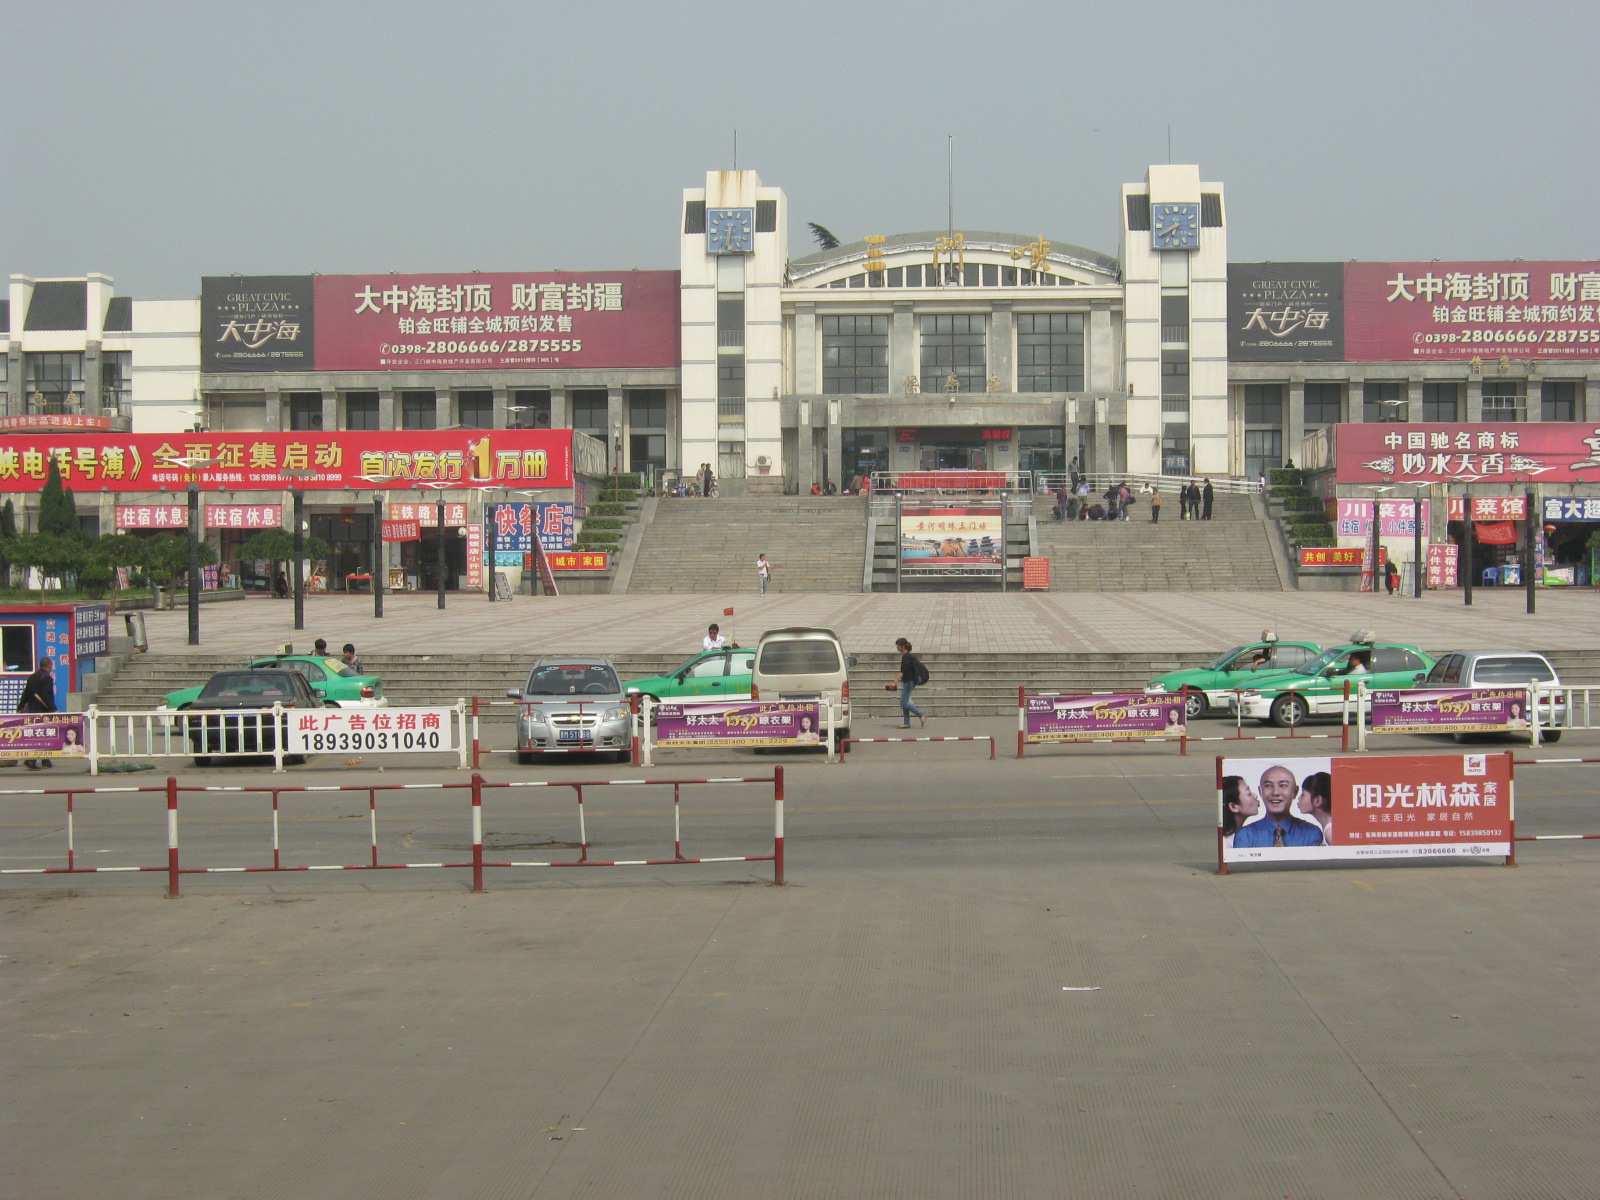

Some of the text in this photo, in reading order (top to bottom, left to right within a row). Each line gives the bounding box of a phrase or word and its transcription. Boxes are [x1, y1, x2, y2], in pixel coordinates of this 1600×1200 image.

[1252, 280, 1320, 290] GREAT CIVIC
[1387, 272, 1529, 302] 大中海封顶
[227, 292, 291, 302] GREAT CIVIC
[354, 282, 623, 314] 大中海封顶 财富封疆
[1264, 290, 1308, 300] PLAZA
[238, 302, 279, 312] PLAZA
[1432, 305, 1600, 323] 铂金旺铺全城预约发
[398, 315, 573, 335] 铂金旺铺全城预约发售
[1242, 307, 1330, 337] 大中海
[216, 319, 301, 349] 大中海
[391, 339, 582, 354] 0398-2806666/2875555
[1384, 431, 1519, 450] 中国驰名商标
[152, 442, 342, 469] 全面征集启动
[360, 434, 548, 481] 首次发行1万册
[1402, 453, 1504, 475] 妙水天香
[1344, 503, 1424, 517] 川菜馆
[1450, 499, 1523, 514] 川菜馆
[123, 508, 150, 526] 住宿
[155, 507, 183, 525] 休息
[214, 508, 275, 526] 住宿 休息
[495, 504, 563, 536] 快餐店
[1342, 520, 1359, 534] 住宿
[556, 557, 576, 566] 城市
[583, 556, 603, 566] 家园
[1304, 552, 1326, 562] 共创
[1333, 552, 1354, 562] 美好
[1429, 546, 1442, 585] 小件寄存
[1445, 546, 1457, 585] 住宿休息
[1128, 696, 1181, 705] 此广告位出租
[1471, 690, 1523, 699] 此广告位出租
[759, 704, 814, 713] 此广告位出租
[1056, 709, 1159, 720] 好太太 晾衣架
[1401, 702, 1502, 713] 好太太 晾衣架
[23, 716, 79, 725] 此广告位出租
[299, 713, 441, 731] 此广告位招商
[686, 715, 792, 726] 好太太 晾衣架
[24, 728, 56, 737] 晾衣架
[301, 732, 440, 751] 18939031040
[1352, 782, 1481, 809] 阳光林森
[1483, 782, 1498, 807] 家居
[1369, 812, 1474, 823] 生活阳光 家居自然
[1459, 829, 1502, 837] 15839850132
